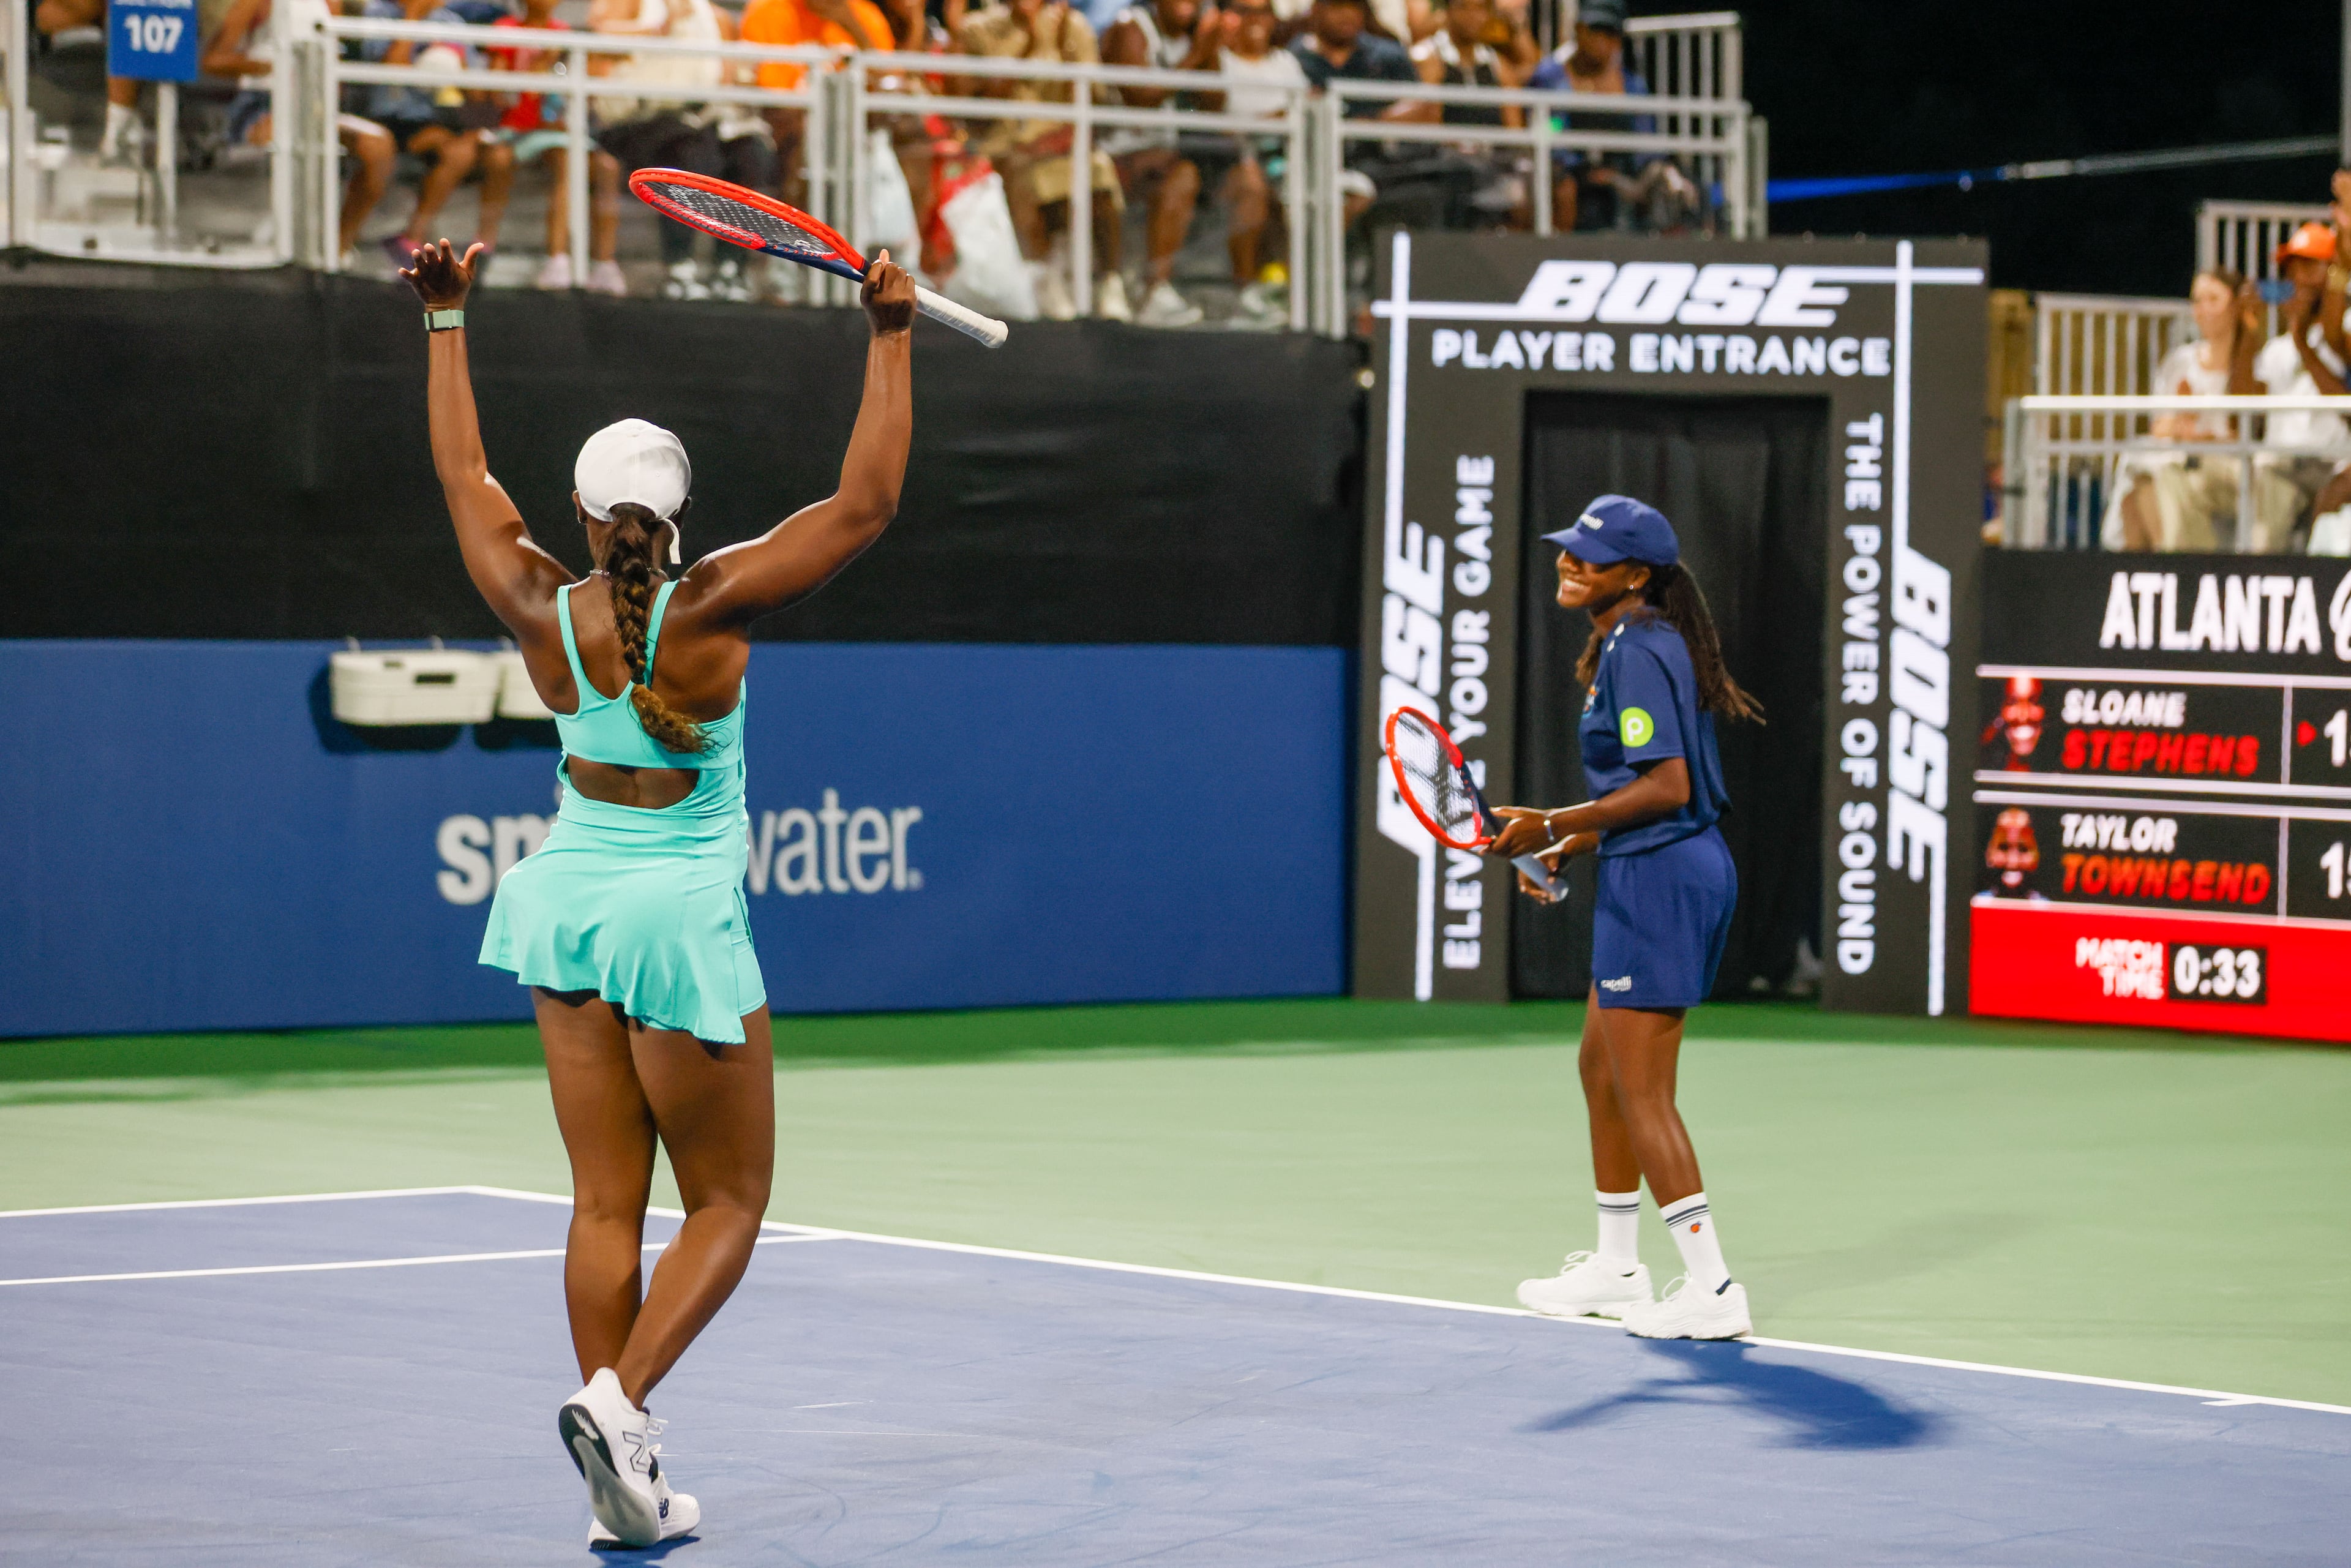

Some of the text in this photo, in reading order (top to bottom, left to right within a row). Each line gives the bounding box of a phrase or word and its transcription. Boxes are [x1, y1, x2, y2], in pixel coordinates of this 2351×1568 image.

[124, 13, 183, 53] 107
[1518, 260, 1849, 327] BOSE
[1432, 329, 1891, 376] PLAYER ENTRANCE
[1453, 455, 1494, 597] GAME
[2099, 572, 2322, 654] ATLANTA
[1376, 522, 1445, 855] BOSE
[1449, 609, 1490, 745] YOUR
[1838, 413, 1883, 975] THE POWER OF SOUND
[1888, 545, 1951, 883] BOSE
[2061, 688, 2186, 727] SLOANE
[2061, 728, 2260, 777] STEPHENS
[2324, 709, 2351, 768] 1
[2061, 813, 2177, 852] TAYLOR
[2061, 853, 2271, 904] TOWNSEND
[2320, 842, 2351, 899] 1
[2075, 937, 2163, 971] MATCH
[2174, 945, 2260, 999] 0:33
[2098, 966, 2164, 1000] TIME
